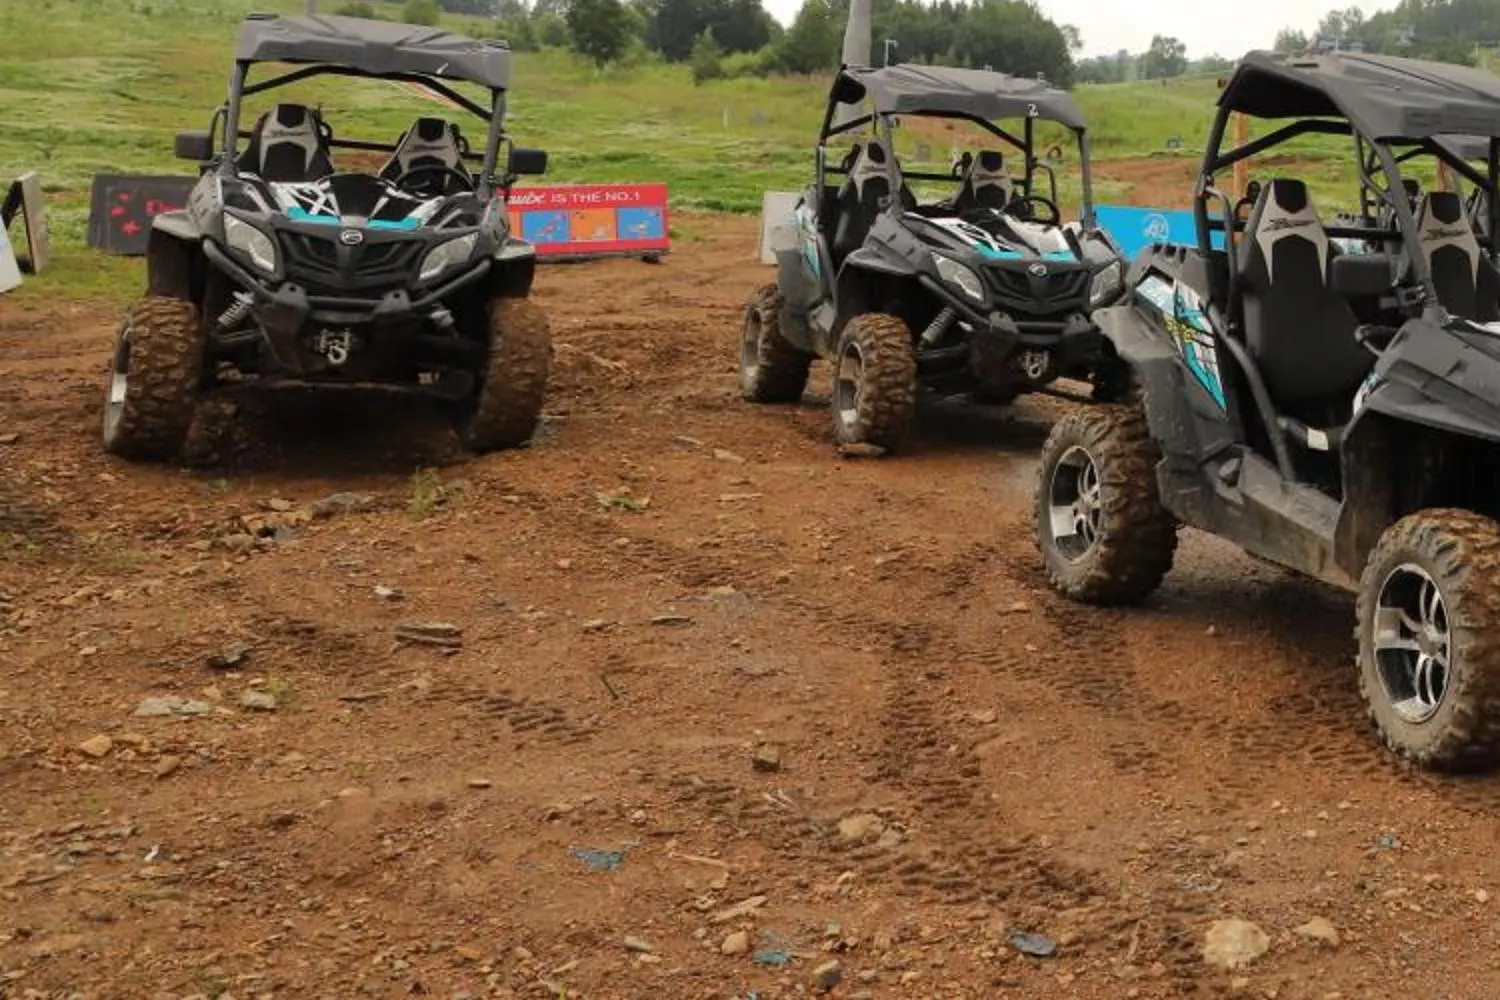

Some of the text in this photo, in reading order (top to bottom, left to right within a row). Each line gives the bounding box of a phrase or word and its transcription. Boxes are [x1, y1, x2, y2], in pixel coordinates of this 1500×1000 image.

[1027, 103, 1039, 117] 2
[551, 193, 567, 203] IS
[569, 193, 602, 203] THE
